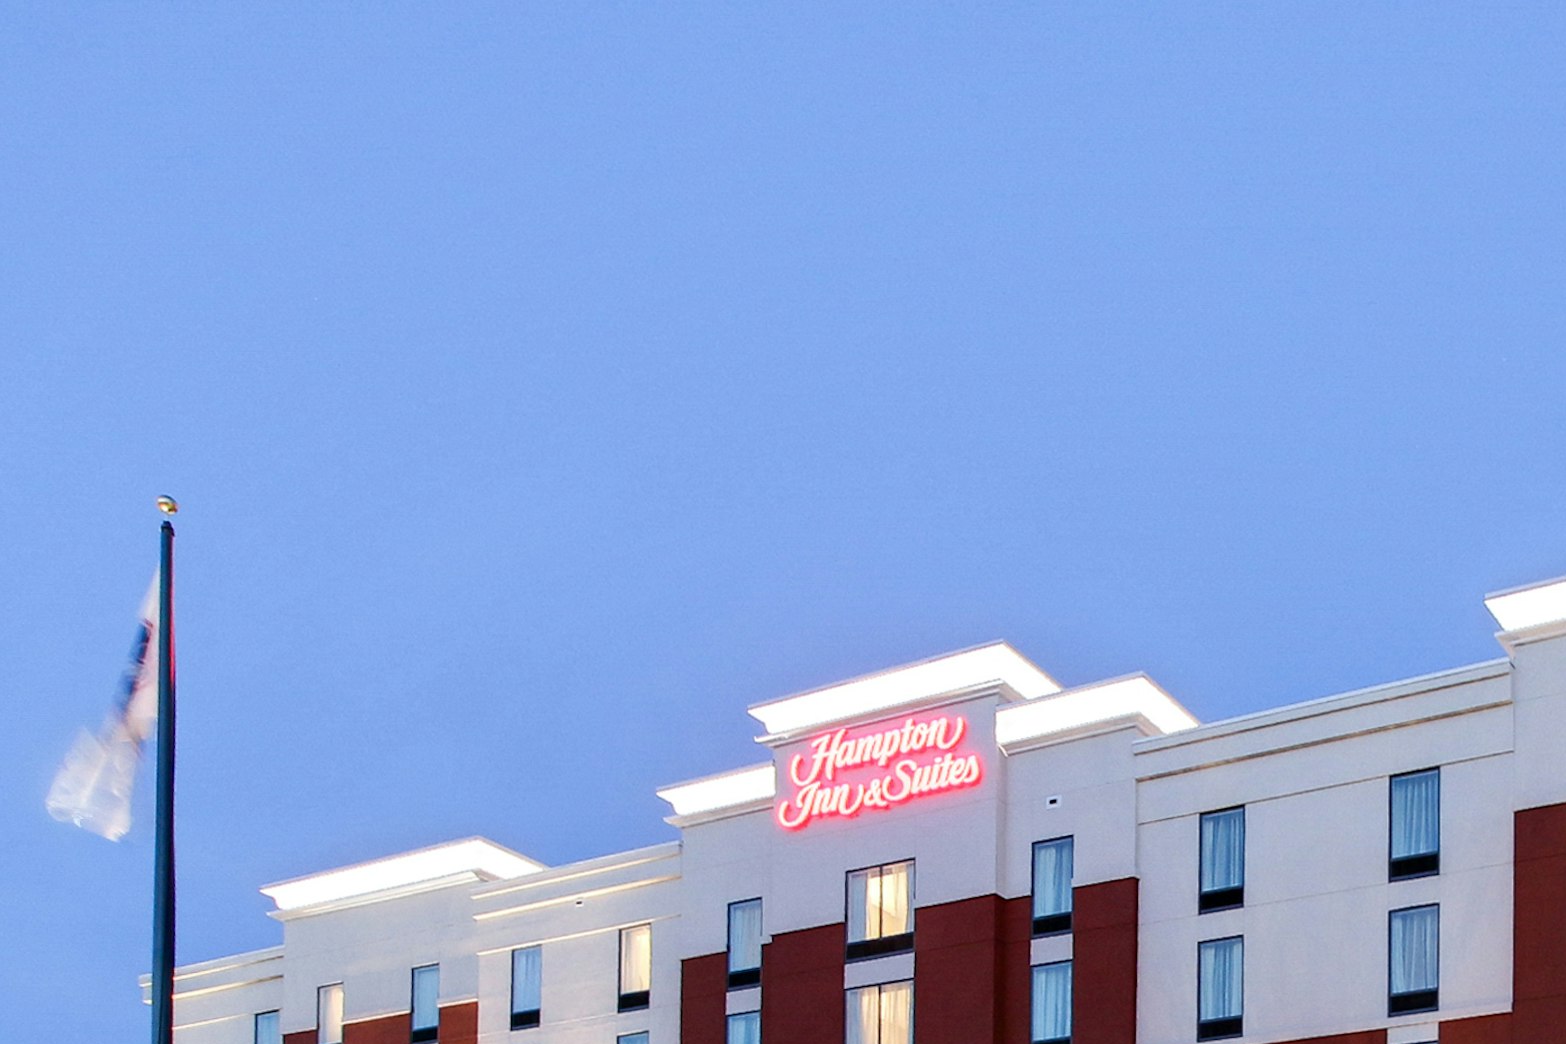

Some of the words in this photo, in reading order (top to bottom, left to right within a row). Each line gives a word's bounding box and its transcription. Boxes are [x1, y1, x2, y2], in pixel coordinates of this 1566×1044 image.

[790, 716, 966, 786] Hampton
[778, 781, 864, 829] Inn
[864, 778, 887, 807] &
[882, 752, 981, 801] Suites
